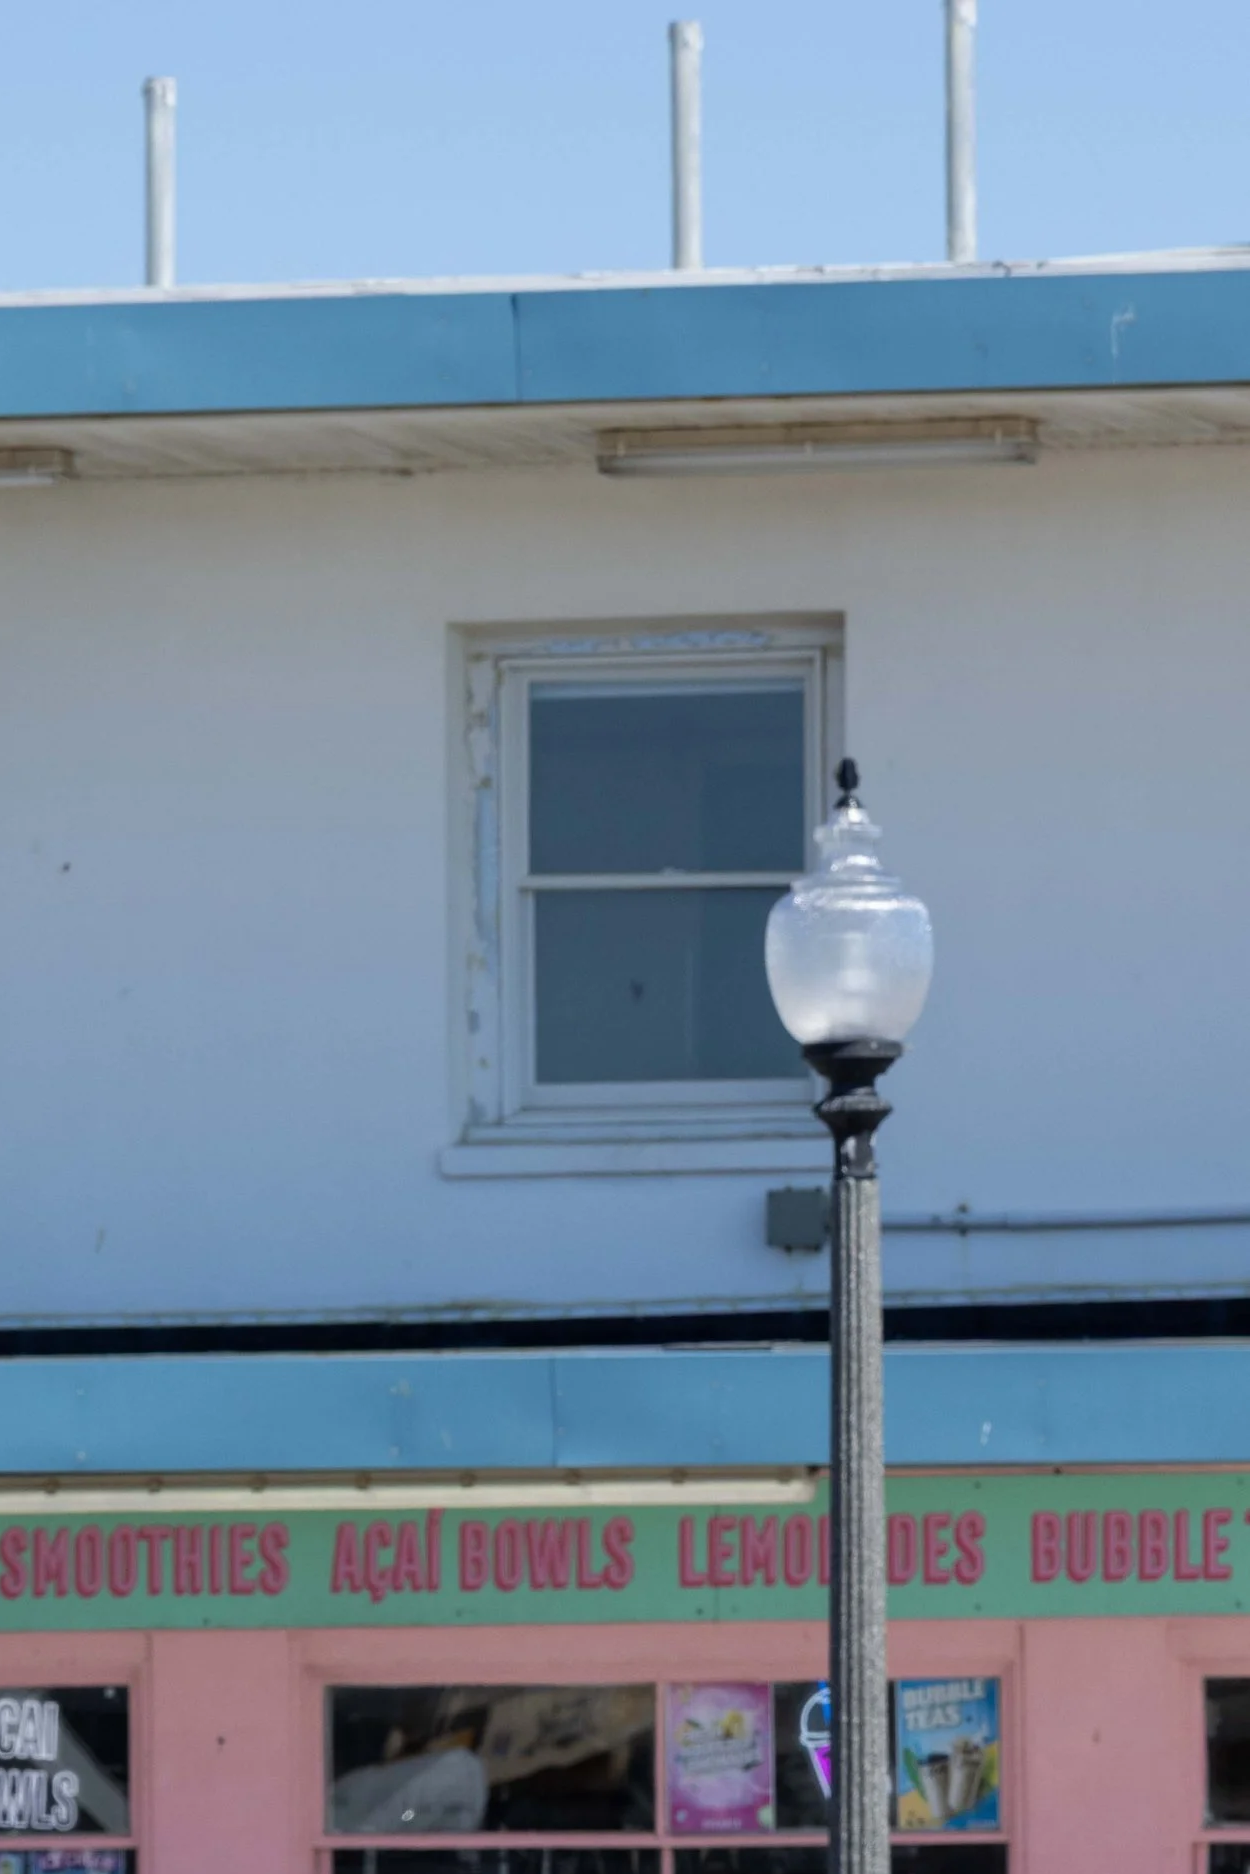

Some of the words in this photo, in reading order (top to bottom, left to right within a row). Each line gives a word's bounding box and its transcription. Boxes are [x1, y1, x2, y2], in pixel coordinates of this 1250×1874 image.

[329, 1508, 445, 1604] AÇAÍ
[458, 1515, 636, 1593] BOWLS
[677, 1510, 986, 1588] LEMODES
[1030, 1507, 1234, 1583] BUBBLE
[905, 1703, 963, 1731] TEAS
